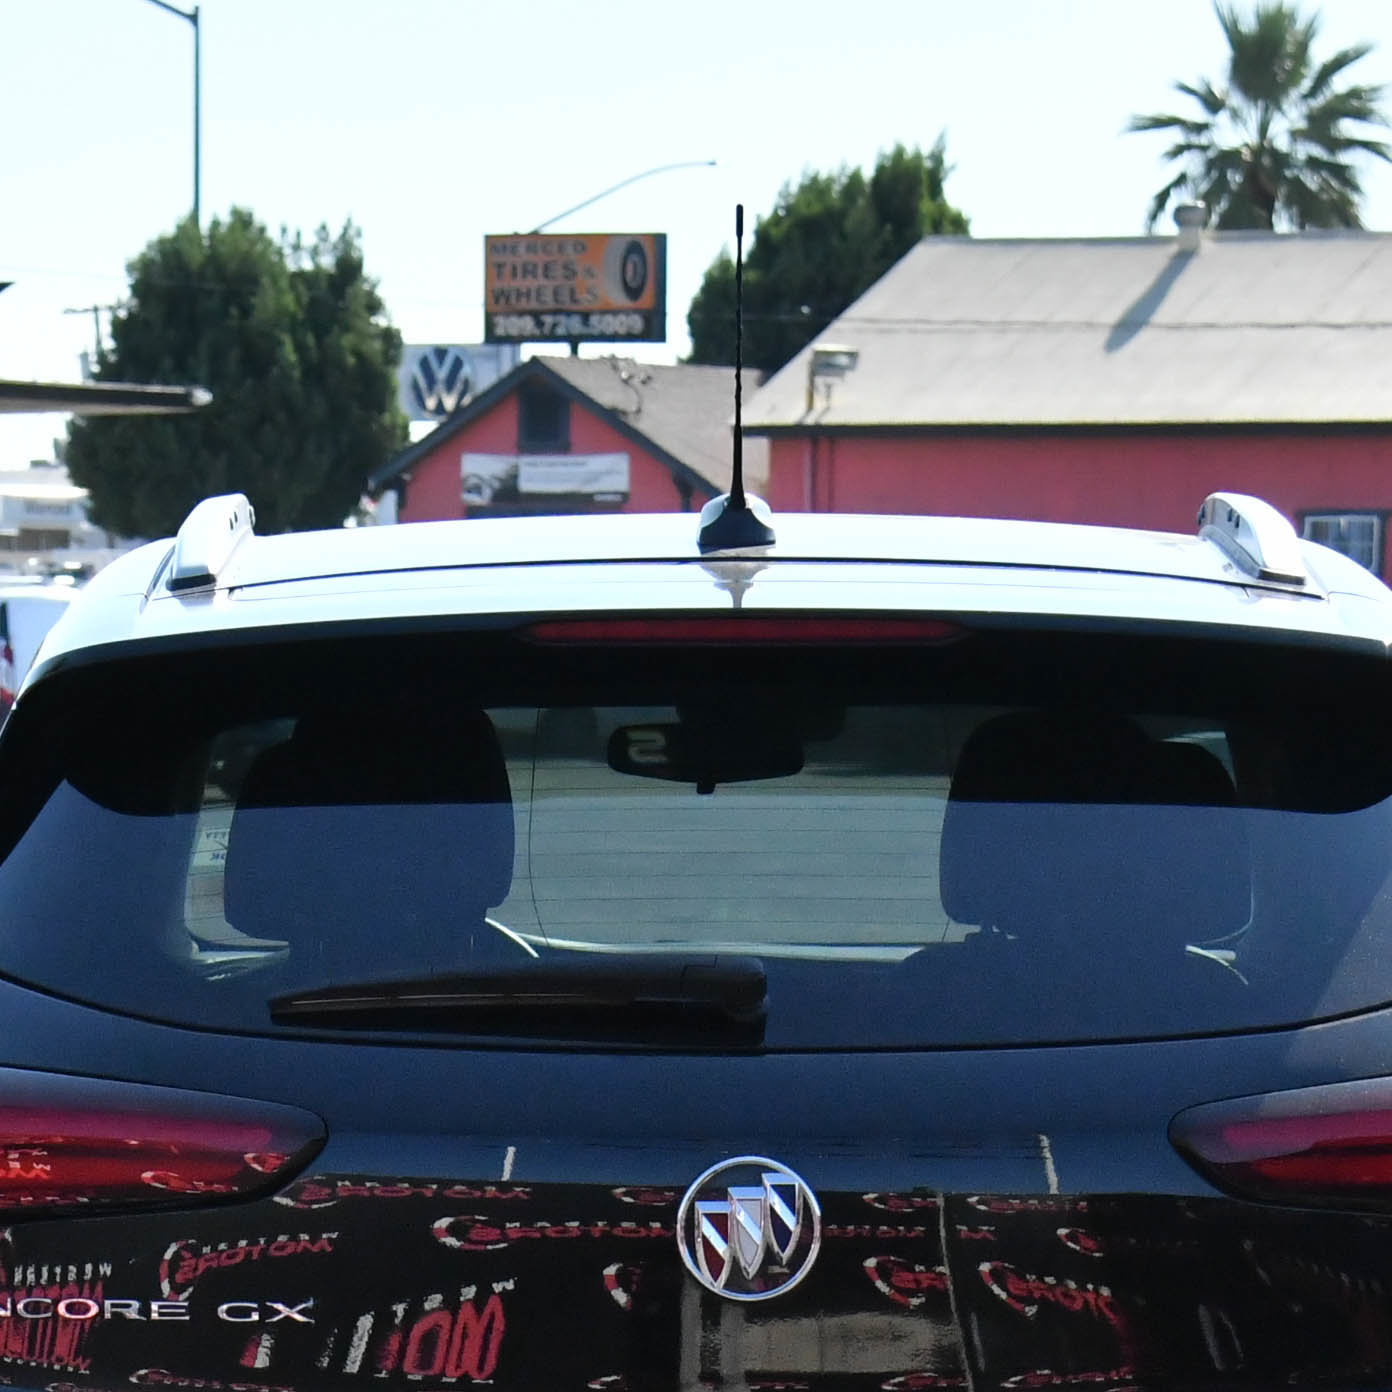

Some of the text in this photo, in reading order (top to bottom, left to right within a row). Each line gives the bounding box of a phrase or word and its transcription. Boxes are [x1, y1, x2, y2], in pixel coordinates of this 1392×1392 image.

[490, 241, 588, 257] MERCED
[493, 261, 579, 280] TIRES
[492, 285, 600, 306] WHEELS
[217, 1298, 315, 1323] GX
